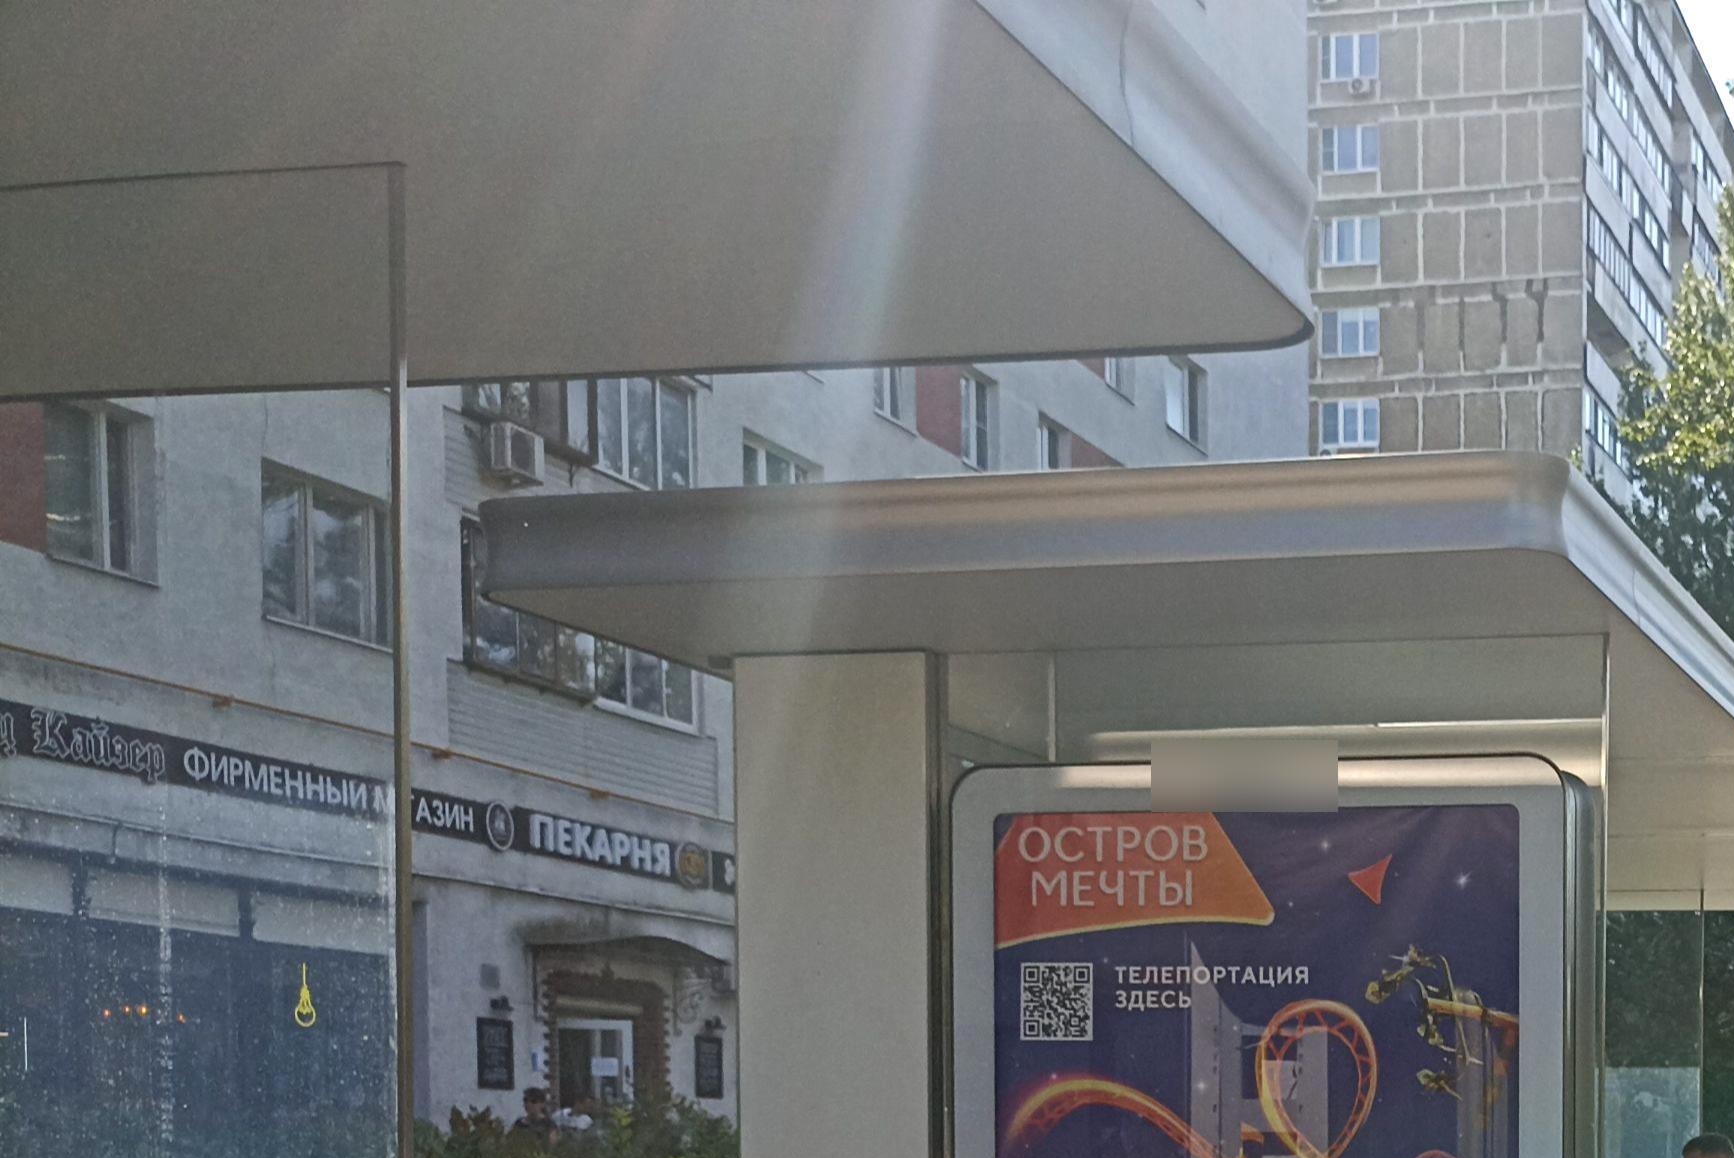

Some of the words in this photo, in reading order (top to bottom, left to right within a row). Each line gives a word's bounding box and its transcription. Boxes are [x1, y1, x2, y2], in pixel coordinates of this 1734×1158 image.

[31, 706, 166, 784] Кайзер
[183, 746, 368, 810] ФИРМЕННЫЙ
[372, 781, 475, 833] МАЗИН
[529, 813, 671, 877] ПЕКАРНЯ
[1017, 824, 1209, 864] ОСТРОВ
[1030, 869, 1194, 908] МЕЧТЫ
[1114, 965, 1310, 987] ТЕЛЕПОРТАЦИЯ
[1114, 989, 1193, 1011] ЗДЕСЬ
